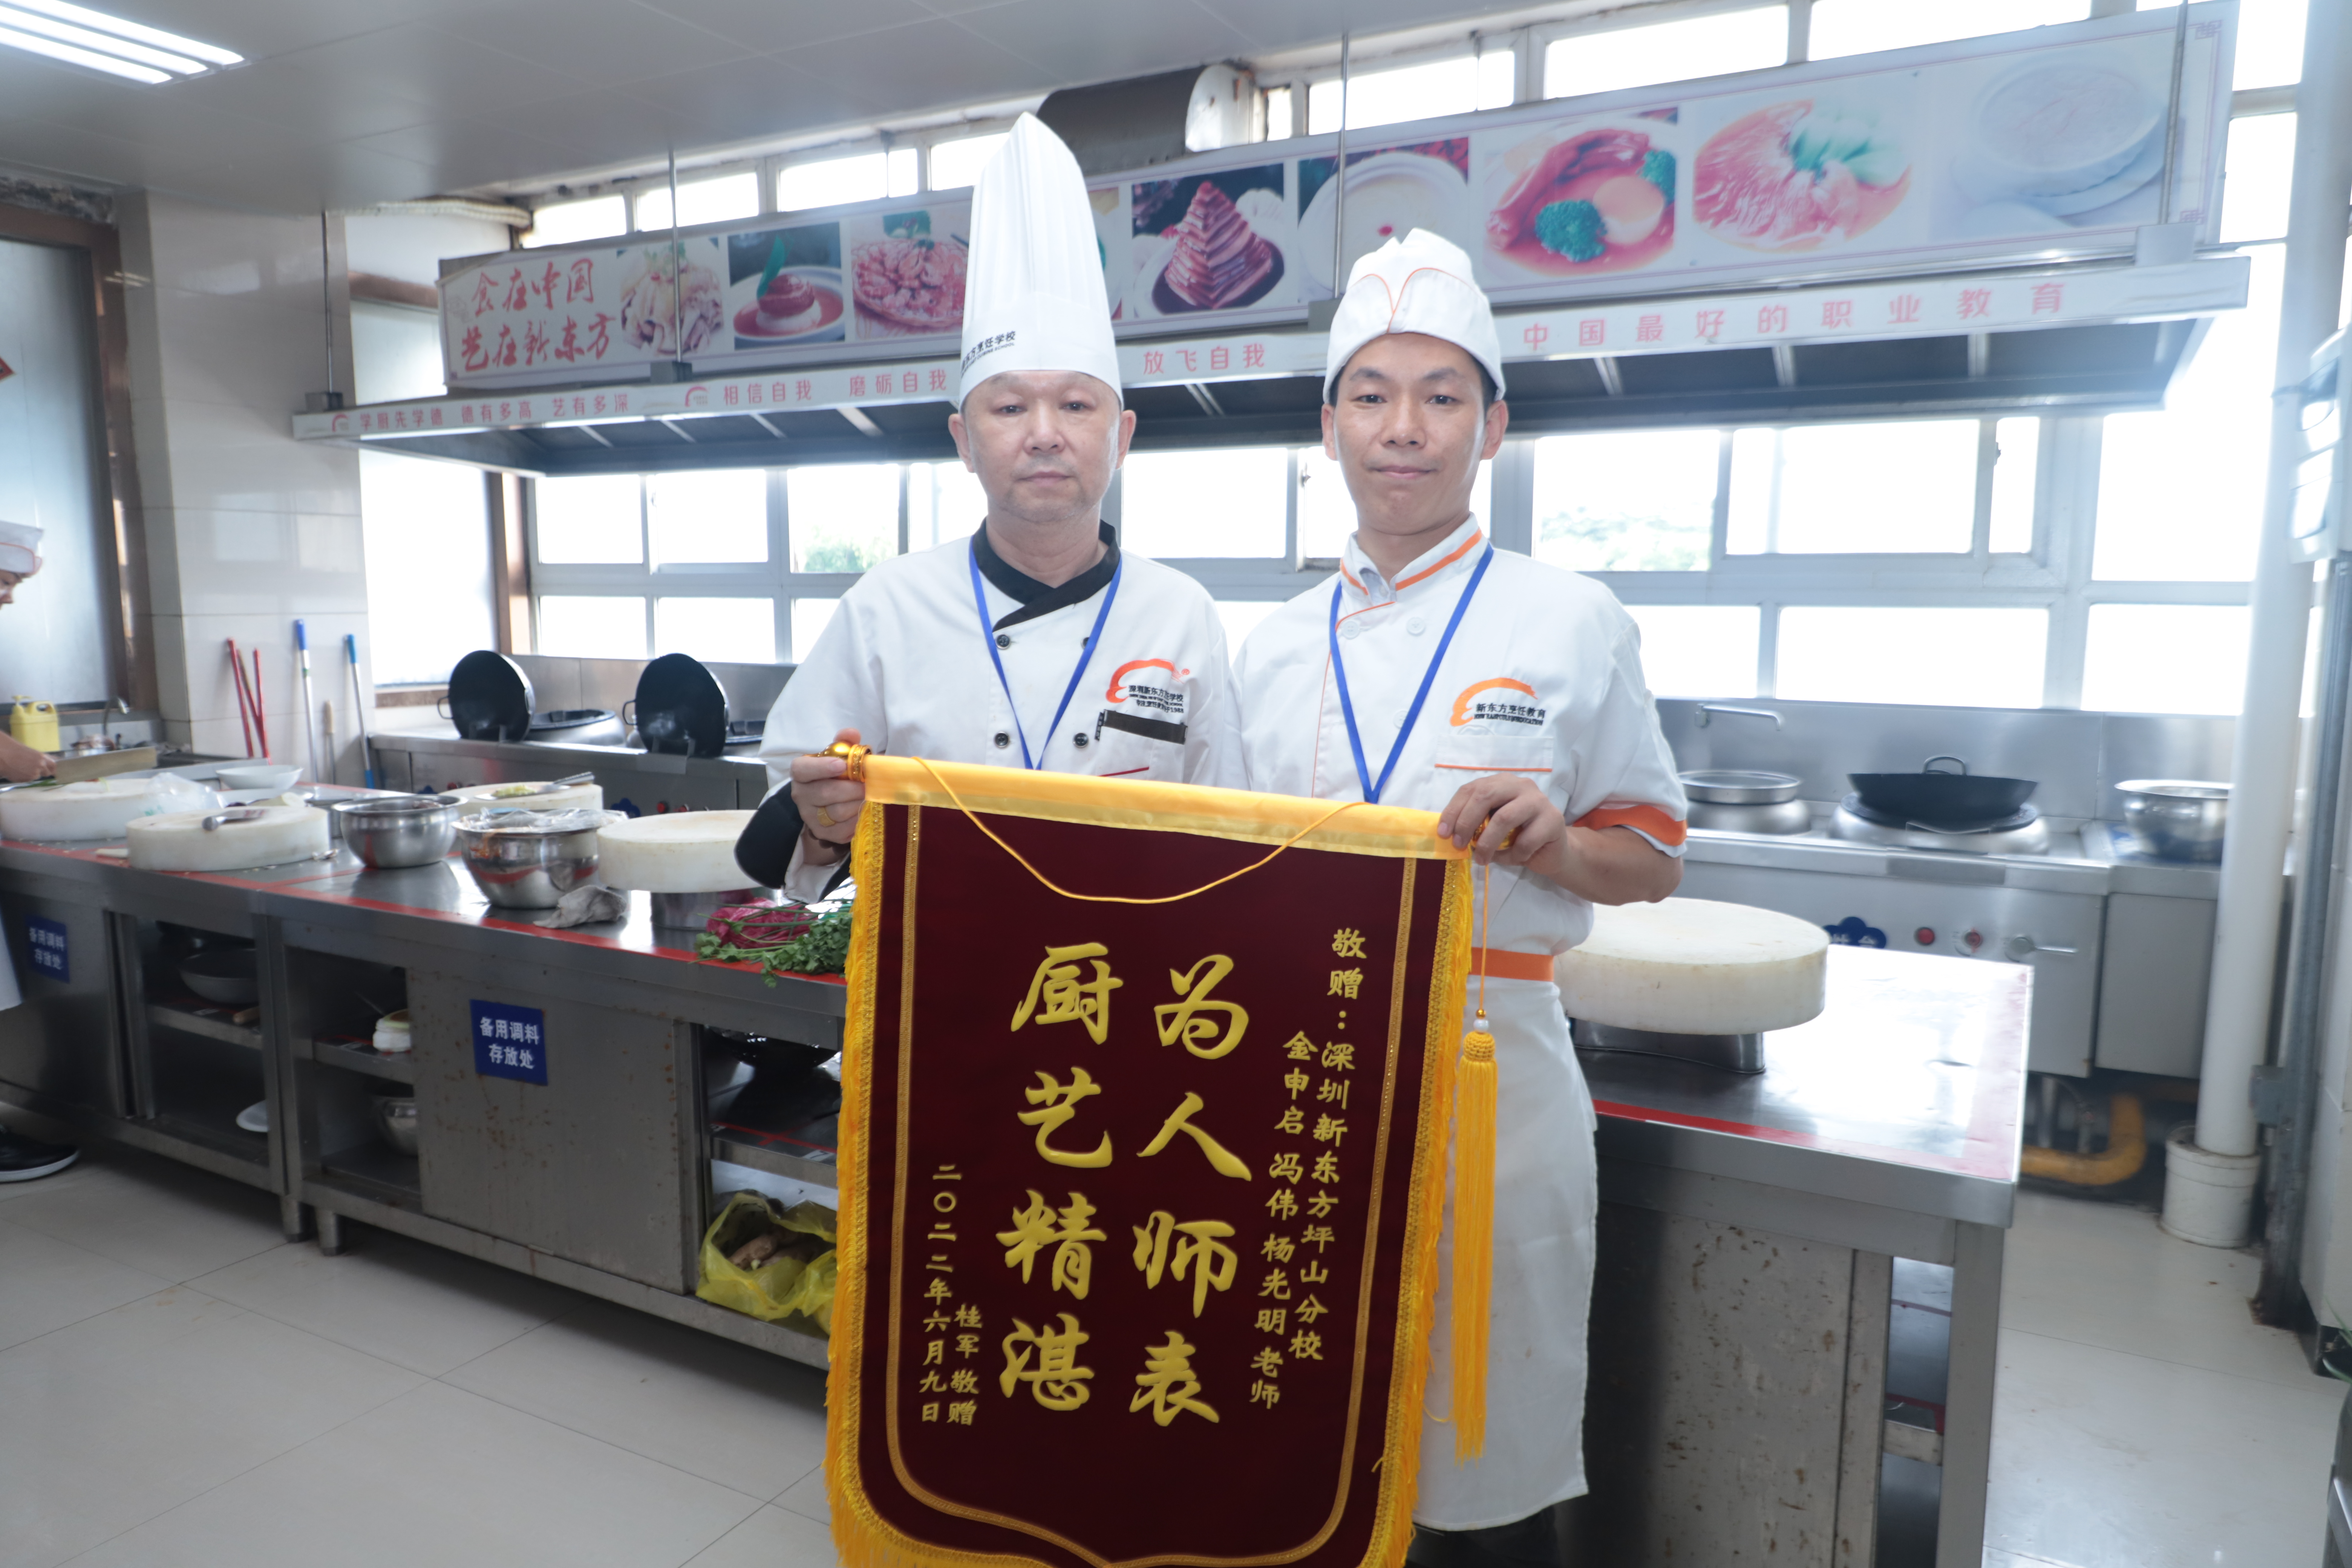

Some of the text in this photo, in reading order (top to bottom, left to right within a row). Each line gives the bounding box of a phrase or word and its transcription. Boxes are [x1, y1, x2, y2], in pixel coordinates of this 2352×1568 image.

[472, 257, 594, 317] 食在中国
[461, 312, 616, 371] 艺在新东方
[994, 342, 1015, 351] SCHOOL
[1523, 283, 2066, 351] 中国最好的职业教育
[723, 379, 812, 406] 相信自我
[849, 369, 947, 397] 磨砺自我
[1144, 343, 1265, 375] 放飞自我
[360, 393, 628, 430] 学厨先学德 德有多高 艺有多深
[1476, 703, 1546, 719] 新东方烹饪教育
[479, 1017, 540, 1045] 备用调料
[488, 1043, 536, 1069] 存放处
[996, 942, 1123, 1411] 厨艺精湛
[946, 1304, 982, 1426] 桂军敬赠
